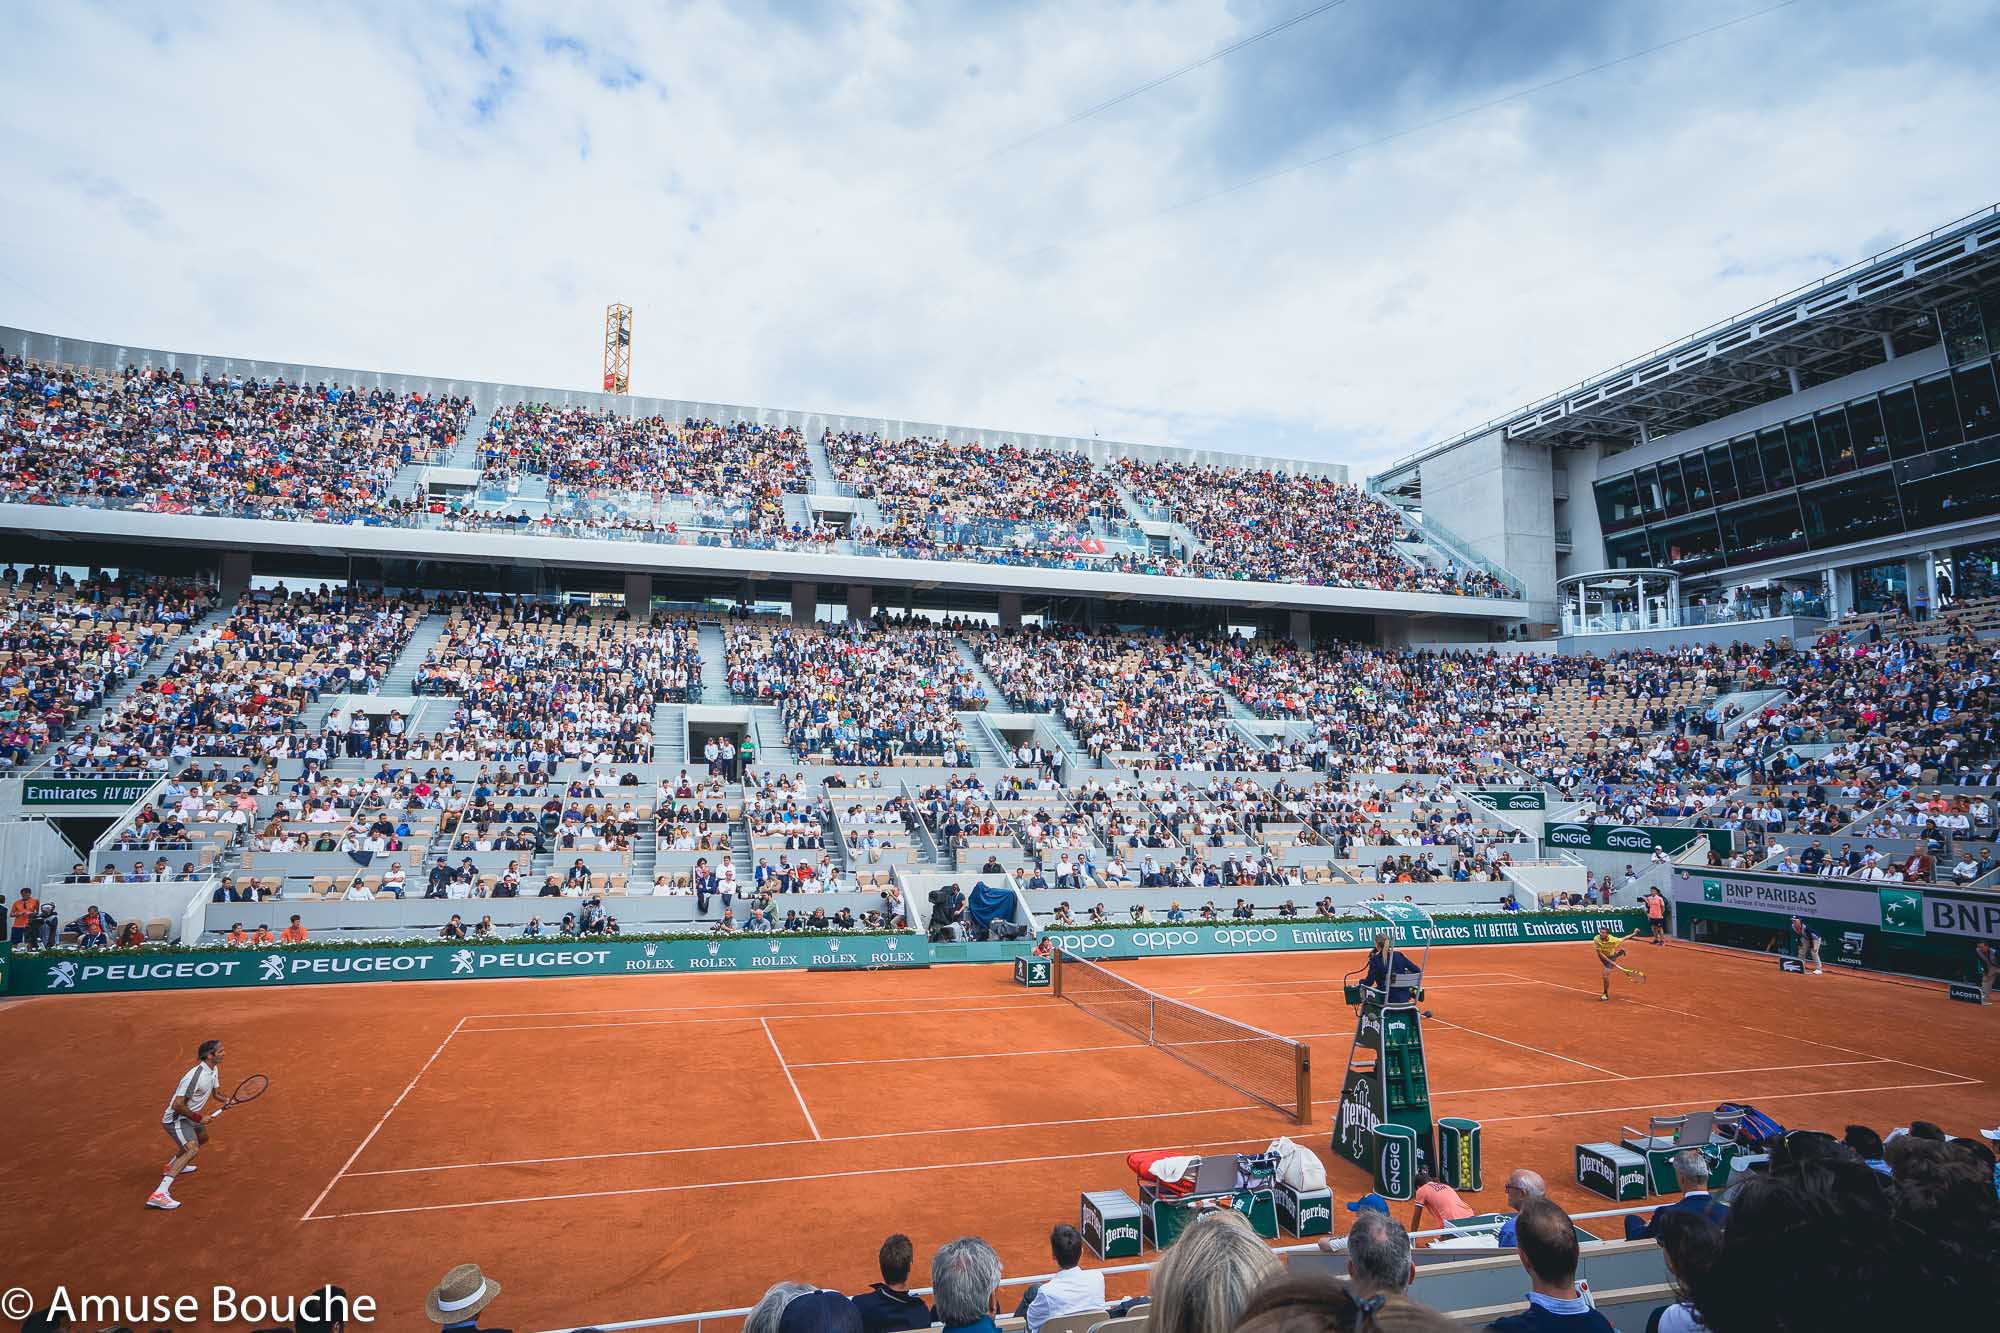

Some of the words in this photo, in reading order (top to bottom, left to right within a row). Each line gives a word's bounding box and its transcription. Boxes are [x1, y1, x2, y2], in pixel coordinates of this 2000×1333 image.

[27, 786, 98, 800] Emirates
[103, 786, 121, 800] FLY
[122, 786, 149, 800] BETT
[1726, 883, 1753, 898] BNP
[1756, 886, 1817, 906] PARIBAS
[1932, 902, 2000, 934] BNP
[1292, 929, 1354, 944] Emirates
[1359, 928, 1372, 942] FLY
[1411, 925, 1470, 940] Emirates
[1474, 923, 1487, 938] FLY
[1489, 922, 1519, 938] BETTER
[1523, 921, 1579, 936] Emirates
[1582, 920, 1594, 934] FLY
[291, 955, 433, 974] PEUGEOT
[479, 950, 611, 968] PEUGEOT
[626, 959, 674, 970] ROLEX
[689, 957, 736, 968] ROLEX
[752, 955, 798, 966] ROLEX
[812, 953, 857, 964] ROLEX
[871, 952, 914, 963] ROLEX
[81, 961, 240, 980] PEUGEOT
[1951, 989, 1981, 1000] LACOSTE
[1579, 1153, 1615, 1185] perrier
[1620, 1170, 1645, 1195] perrier
[1300, 1203, 1330, 1231] perrier
[1105, 1223, 1138, 1252] perrier
